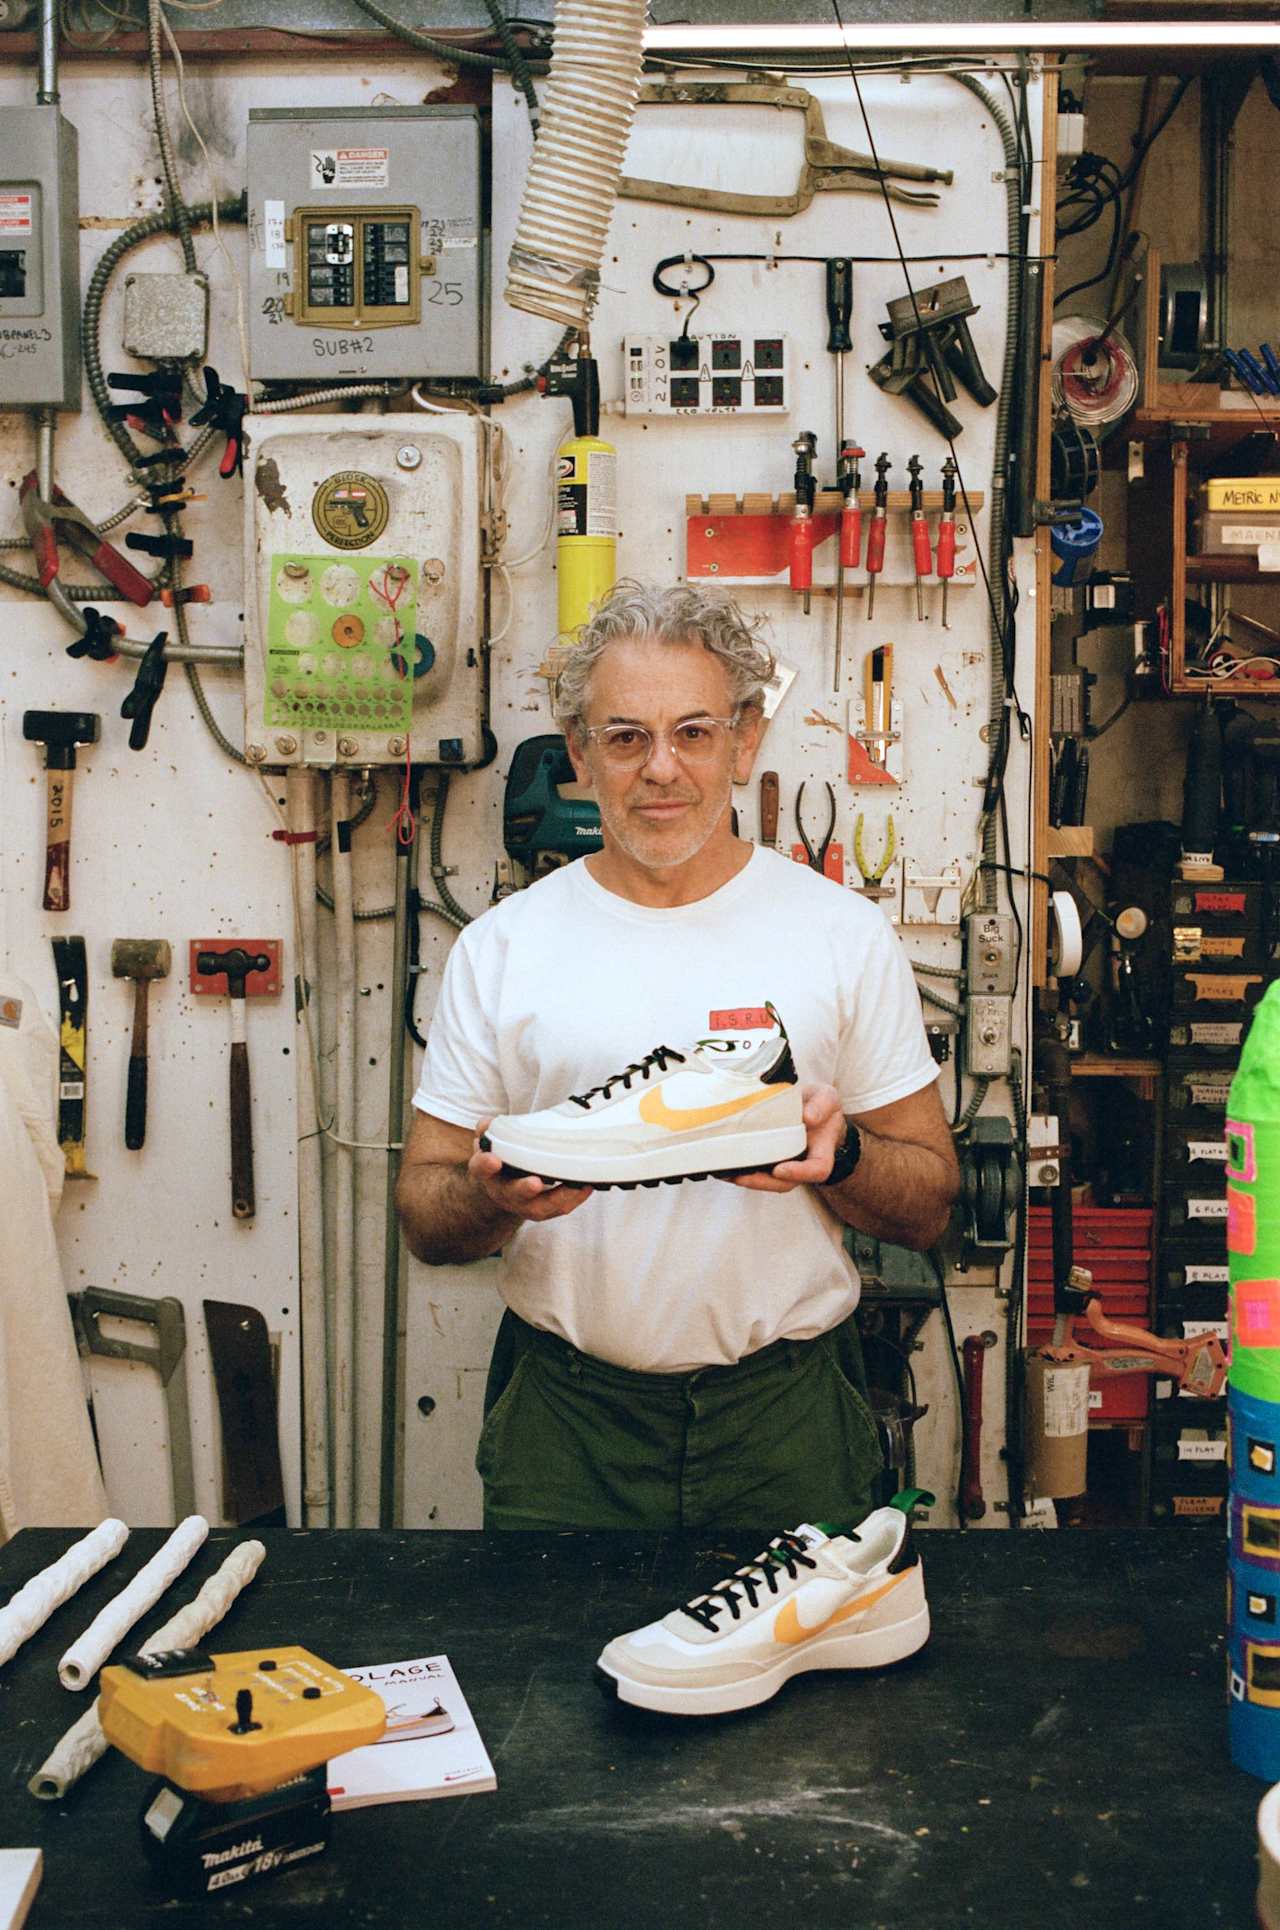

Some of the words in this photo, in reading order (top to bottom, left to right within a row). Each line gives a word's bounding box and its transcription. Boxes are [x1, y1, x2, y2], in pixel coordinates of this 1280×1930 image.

[277, 271, 291, 287] 19
[427, 280, 464, 306] 25
[312, 336, 375, 357] SUB#2
[50, 784, 64, 828] 2015
[978, 934, 1004, 943] Suck
[1204, 1206, 1229, 1214] FLAT
[384, 1673, 446, 1686] MANUAL
